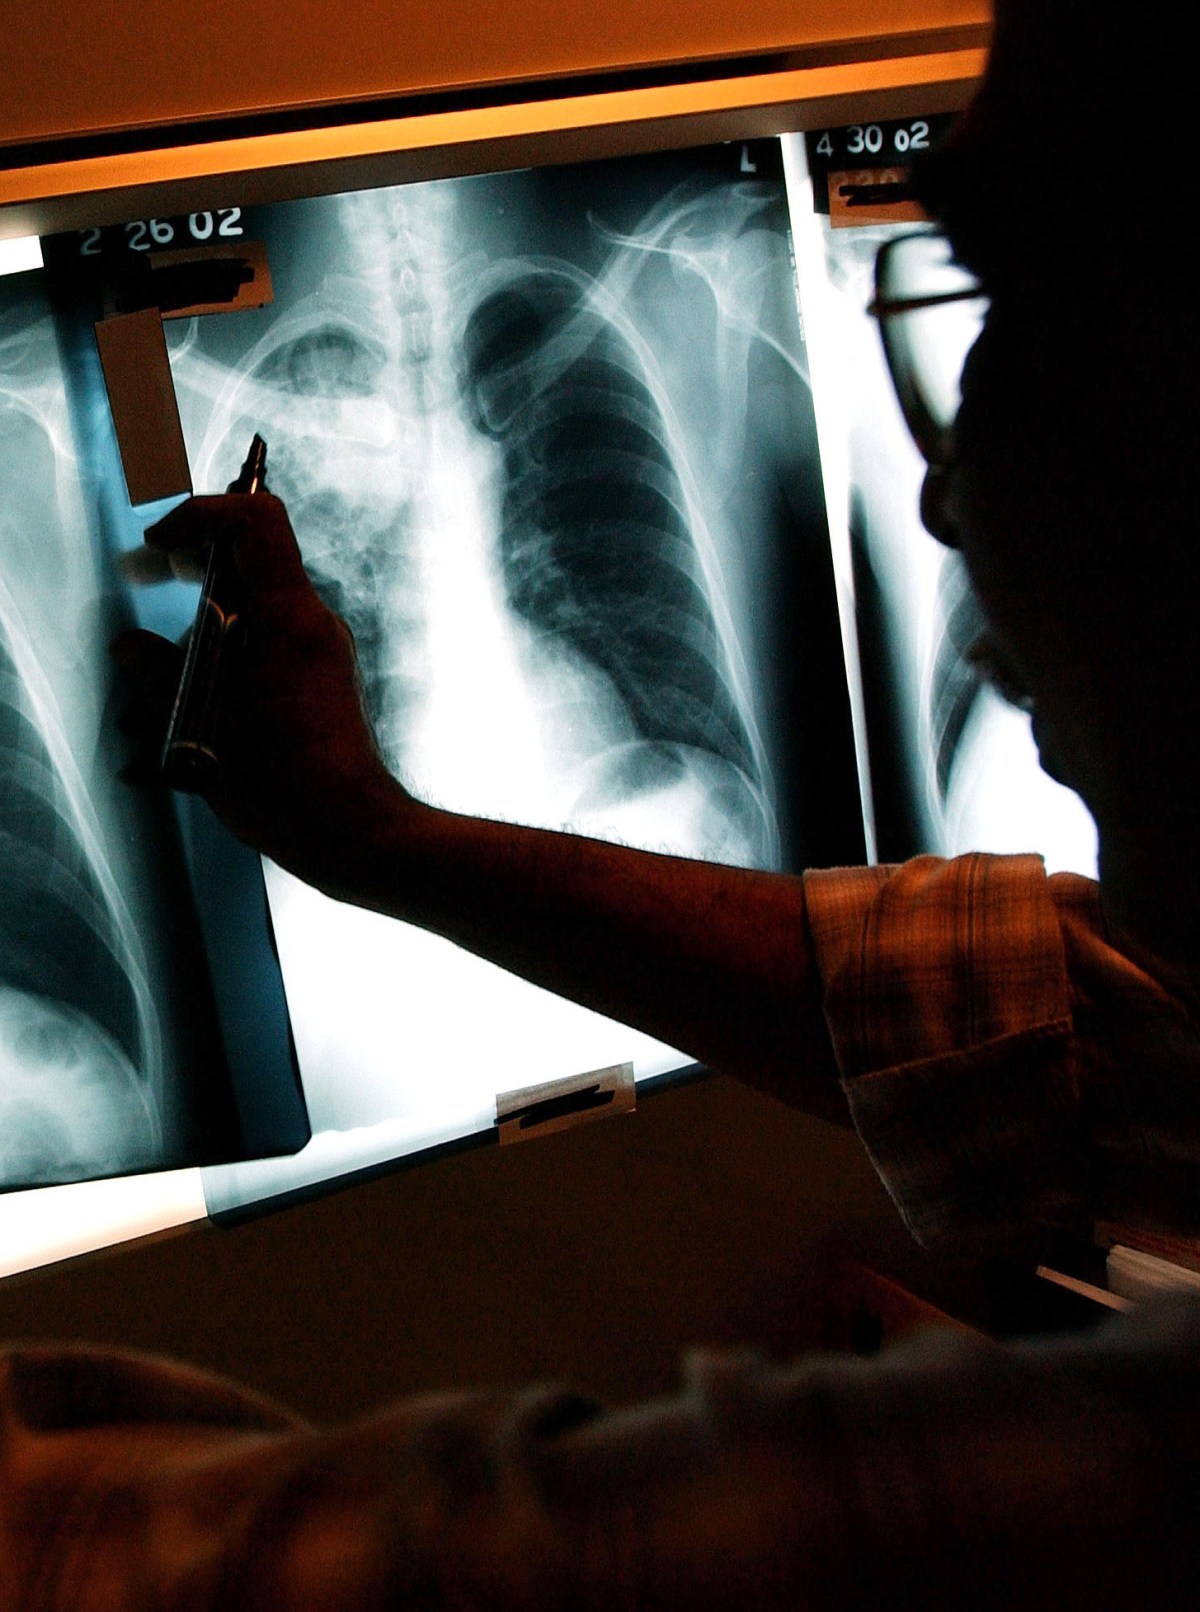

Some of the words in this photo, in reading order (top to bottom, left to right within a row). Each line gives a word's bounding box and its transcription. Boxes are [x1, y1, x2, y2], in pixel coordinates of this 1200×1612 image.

[816, 131, 834, 158] 4
[846, 124, 883, 154] 30
[894, 121, 930, 153] 02
[740, 144, 757, 173] L
[80, 227, 103, 256] 2
[125, 218, 175, 252] 26
[189, 207, 244, 241] 02
